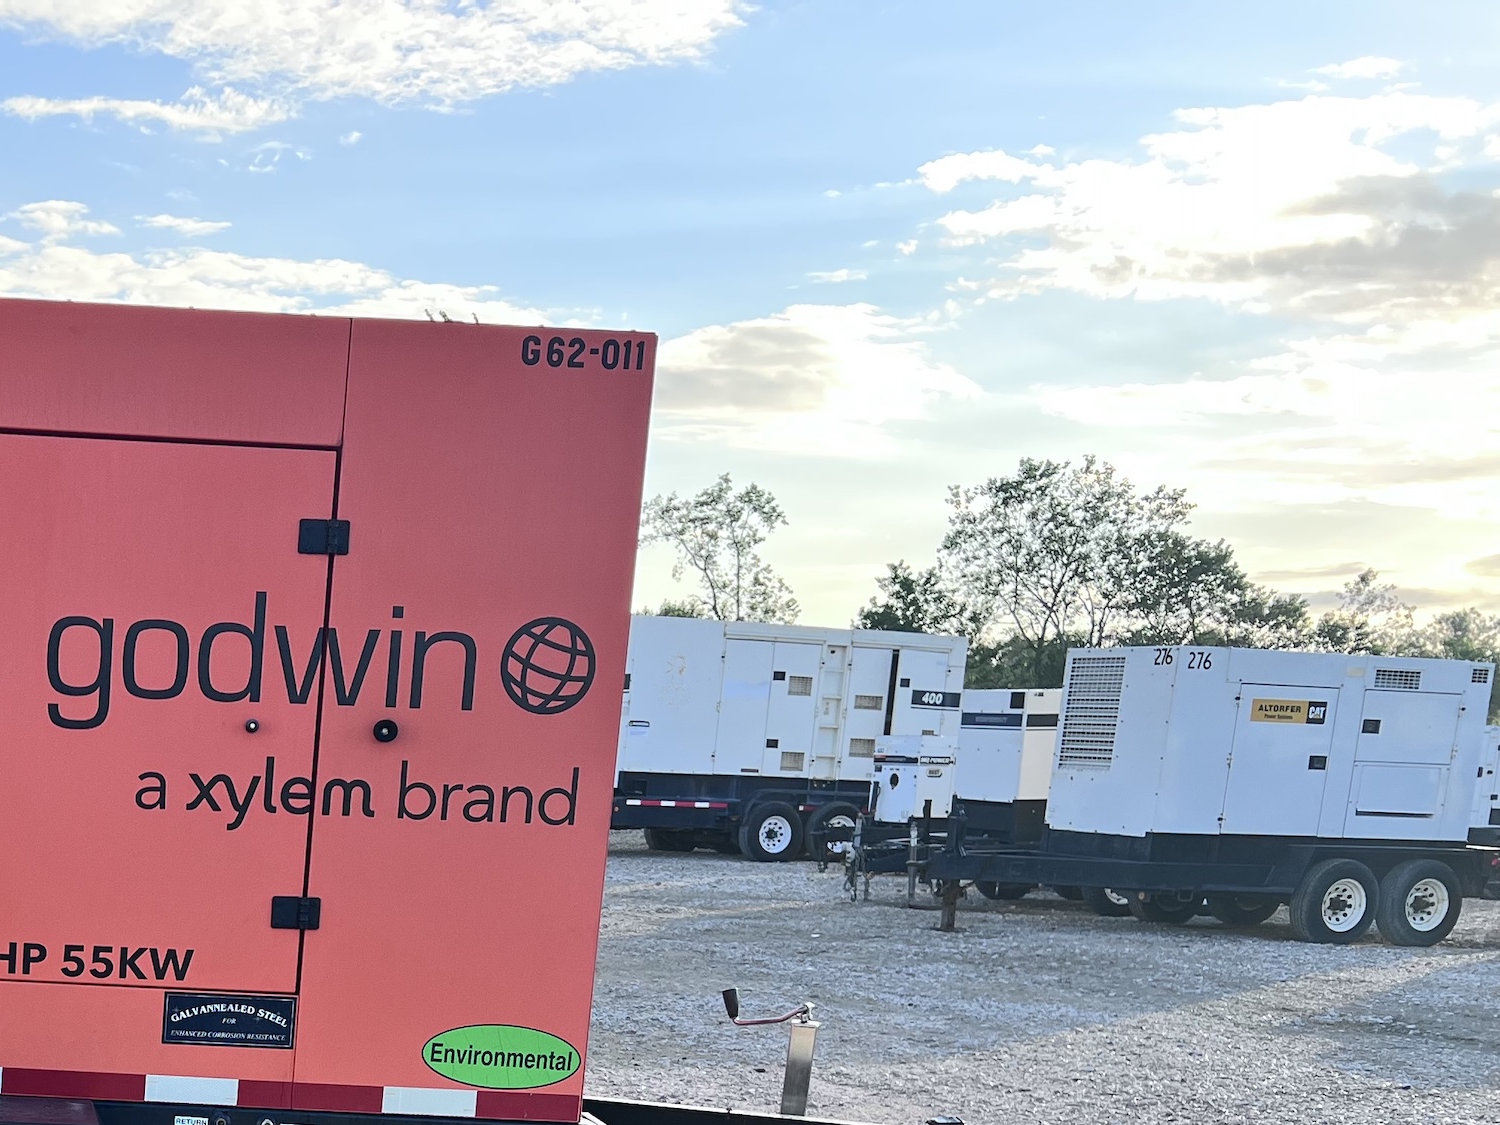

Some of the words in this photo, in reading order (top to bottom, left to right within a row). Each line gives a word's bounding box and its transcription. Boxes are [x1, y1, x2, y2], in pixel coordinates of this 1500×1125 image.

[521, 335, 646, 370] G62-011
[46, 591, 477, 730] godwin
[1153, 648, 1173, 666] 276
[1187, 651, 1212, 670] 276
[921, 692, 944, 705] 400
[1258, 704, 1302, 713] ALTORFER
[1308, 706, 1326, 719] CAT
[135, 771, 167, 811] a
[186, 756, 375, 831] xylem
[397, 760, 580, 826] brand
[60, 944, 195, 982] 55KW
[170, 1003, 255, 1022] GALVANNEALED
[256, 1008, 288, 1028] STEEL
[221, 1017, 237, 1025] FOR
[170, 1029, 207, 1038] ENHANCED
[207, 1031, 246, 1040] CORROSION
[246, 1033, 287, 1041] RESISTANCE
[430, 1042, 573, 1071] Environmental
[175, 1118, 207, 1125] RETURN
